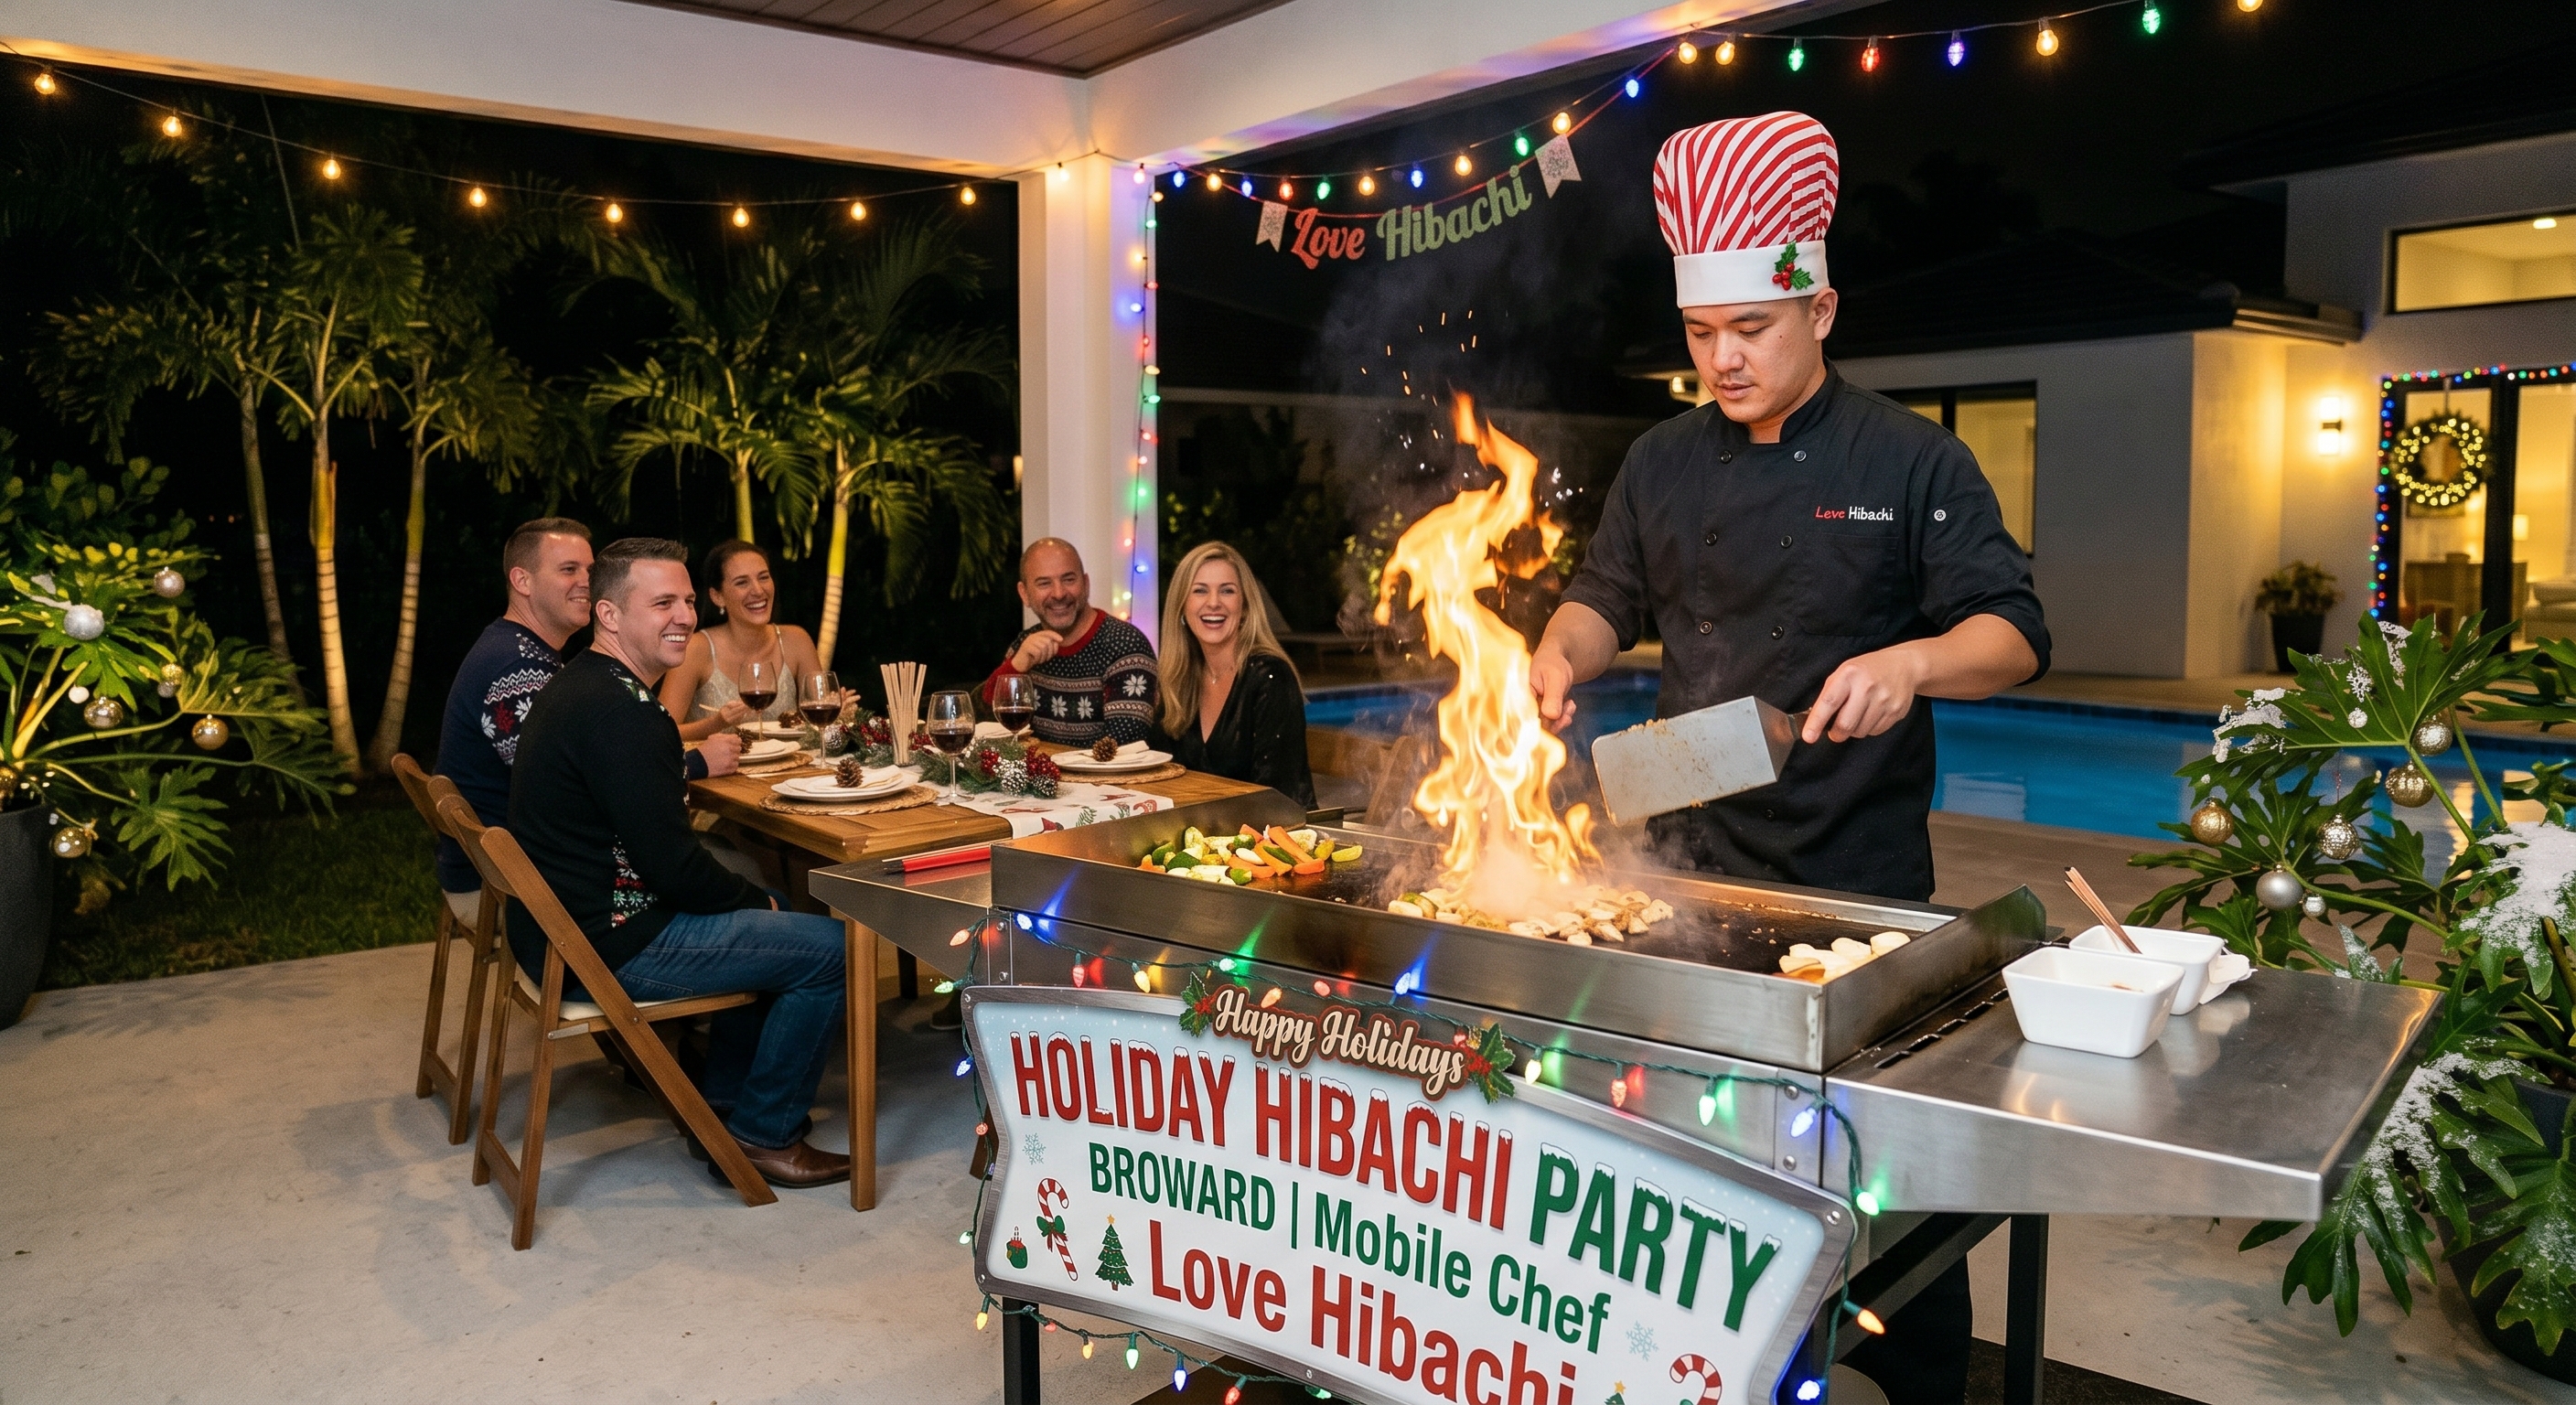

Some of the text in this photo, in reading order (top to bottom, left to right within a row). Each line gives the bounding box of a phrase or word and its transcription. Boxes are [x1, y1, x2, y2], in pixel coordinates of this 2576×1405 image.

[1291, 165, 1532, 270] Love Hibachi
[1848, 506, 1894, 520] Hibachi
[1216, 989, 1465, 1096] Happy Holidays
[1010, 1031, 1782, 1332] HOLIDAY HIBACHI PARTY
[1089, 1142, 1275, 1231] BROWARD
[1315, 1192, 1471, 1298] Mobile
[1488, 1254, 1611, 1354] Chef
[1150, 1220, 1286, 1332] Love
